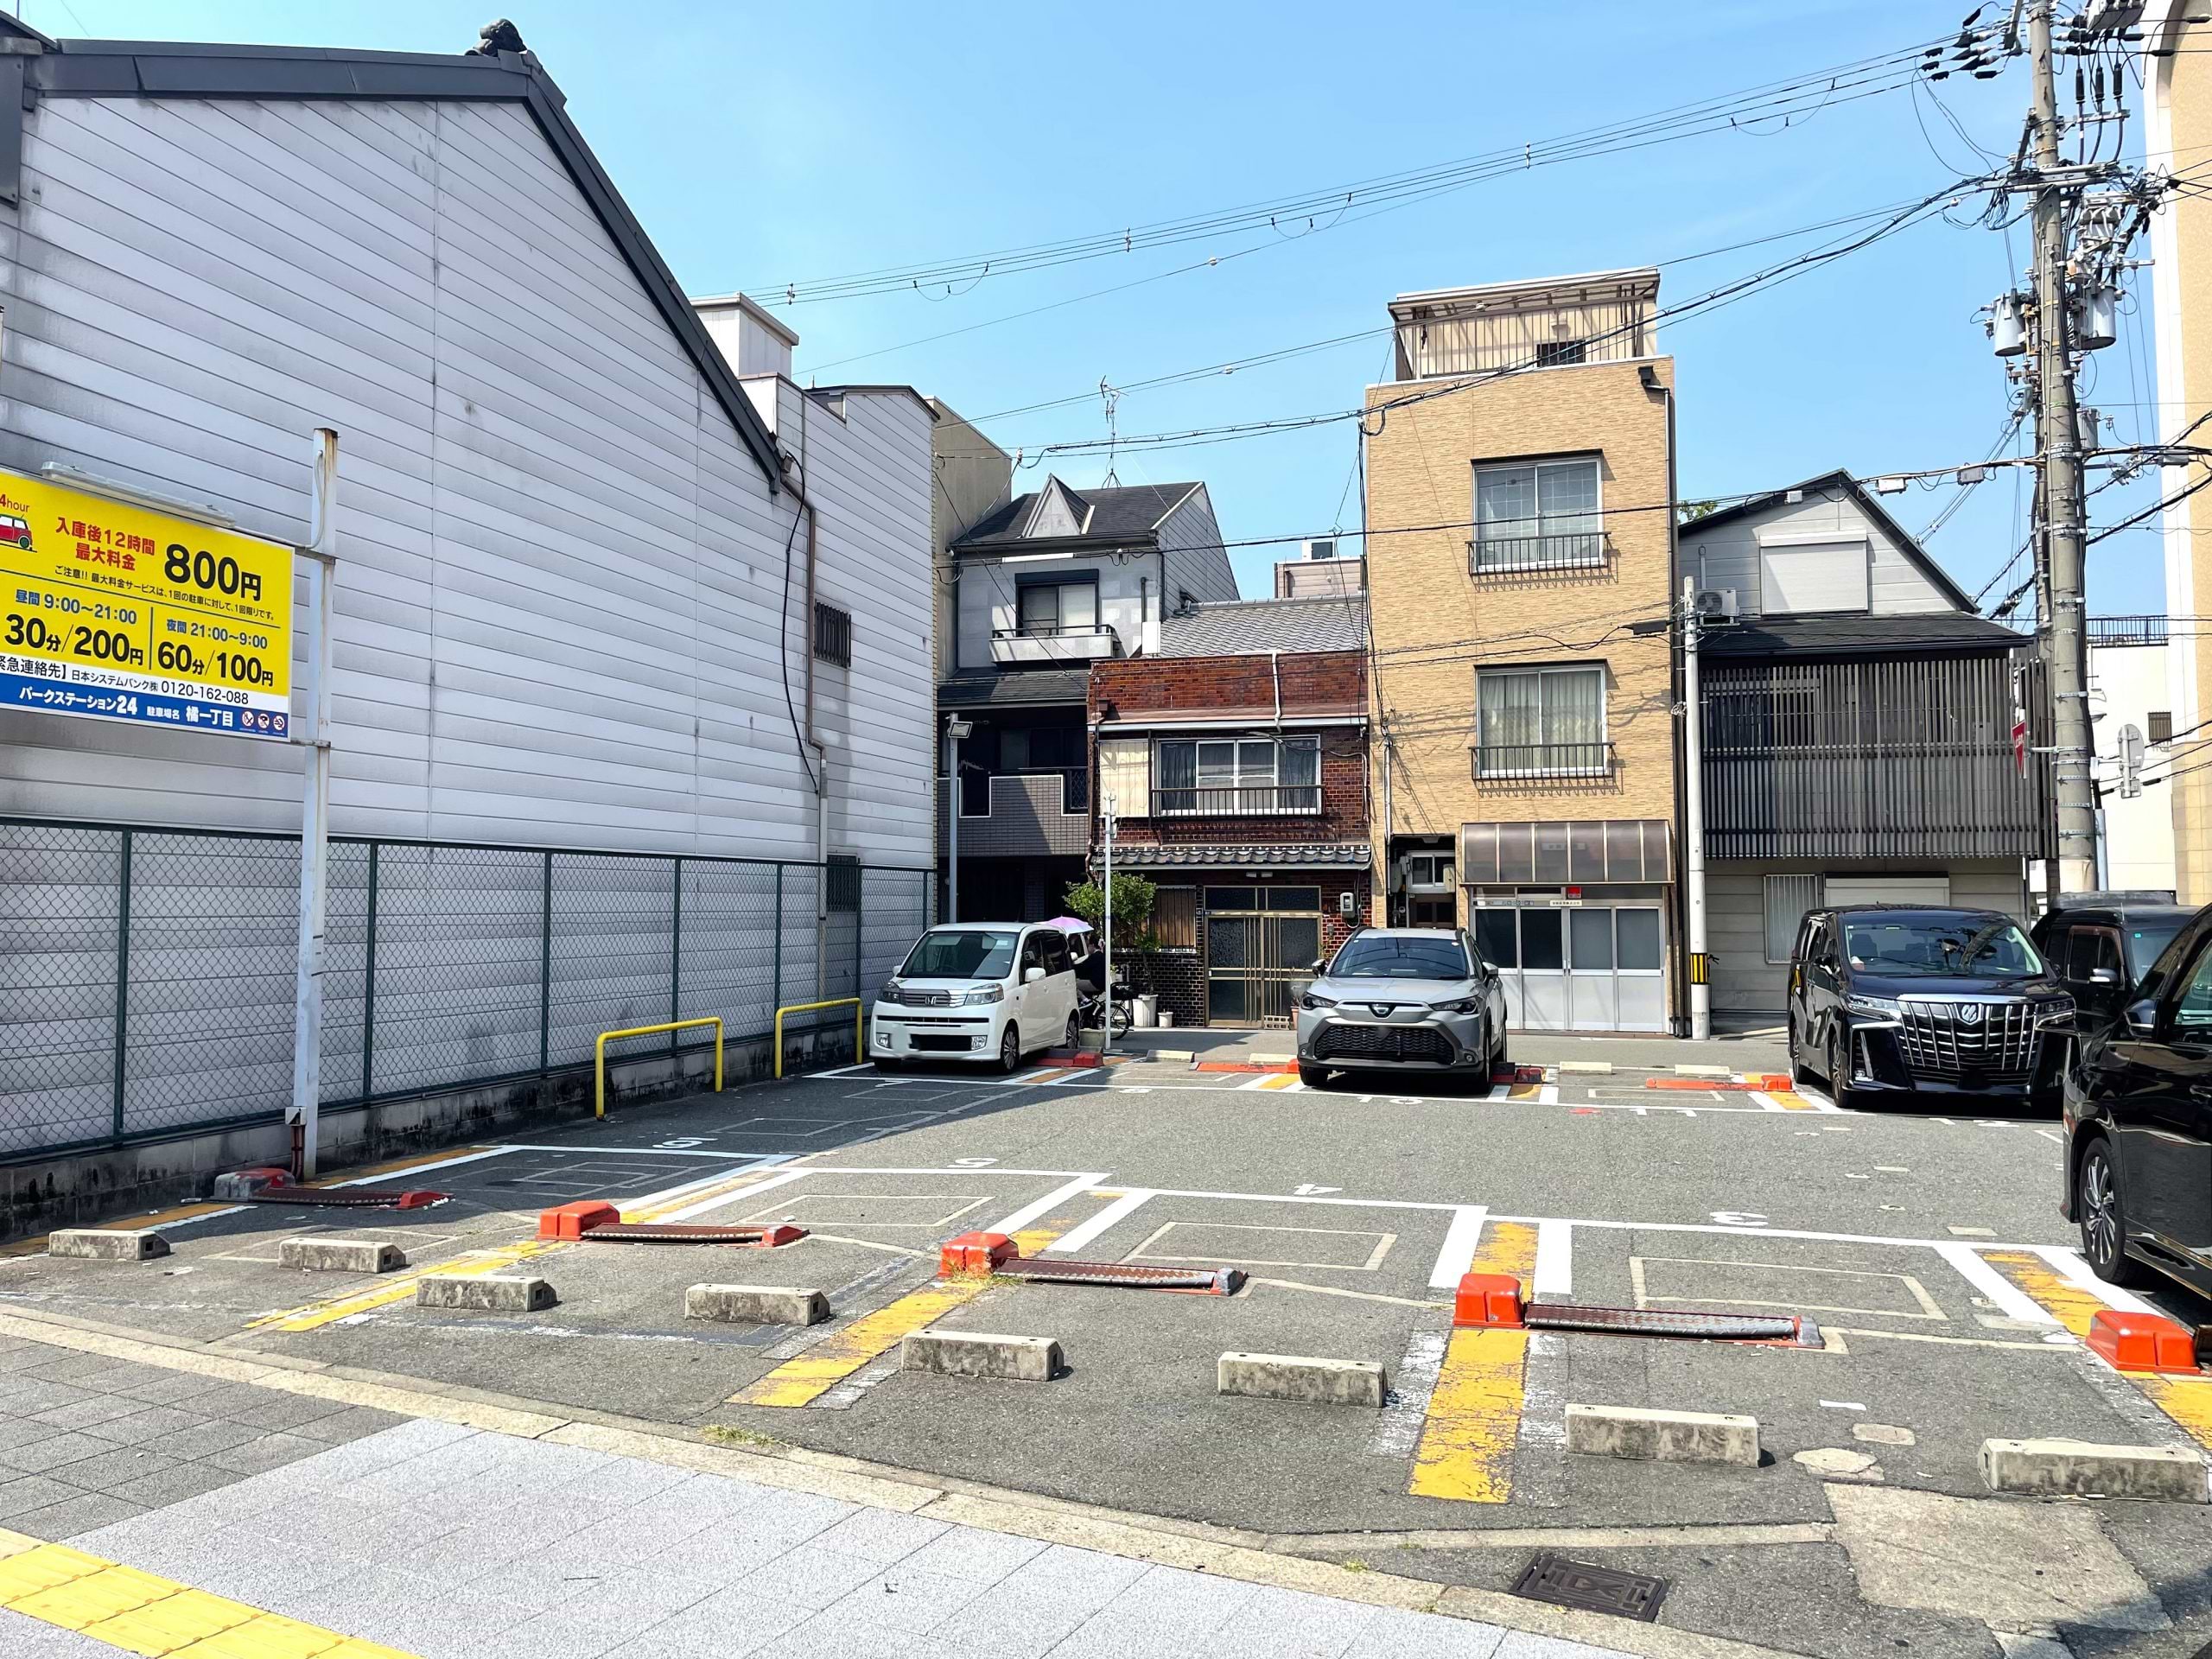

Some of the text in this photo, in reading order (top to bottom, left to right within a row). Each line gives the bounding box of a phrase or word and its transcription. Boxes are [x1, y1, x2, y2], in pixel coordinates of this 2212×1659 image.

[55, 517, 156, 556] 入庫後12時間
[75, 542, 136, 571] 最大料金
[164, 543, 261, 601] 800円
[16, 589, 41, 607] 昼間
[4, 613, 143, 666] 30分/200円
[167, 619, 187, 634] 夜間
[158, 641, 274, 688] 60分/100円
[162, 680, 250, 705] 0120-162-088
[146, 706, 181, 721] 駐車場名
